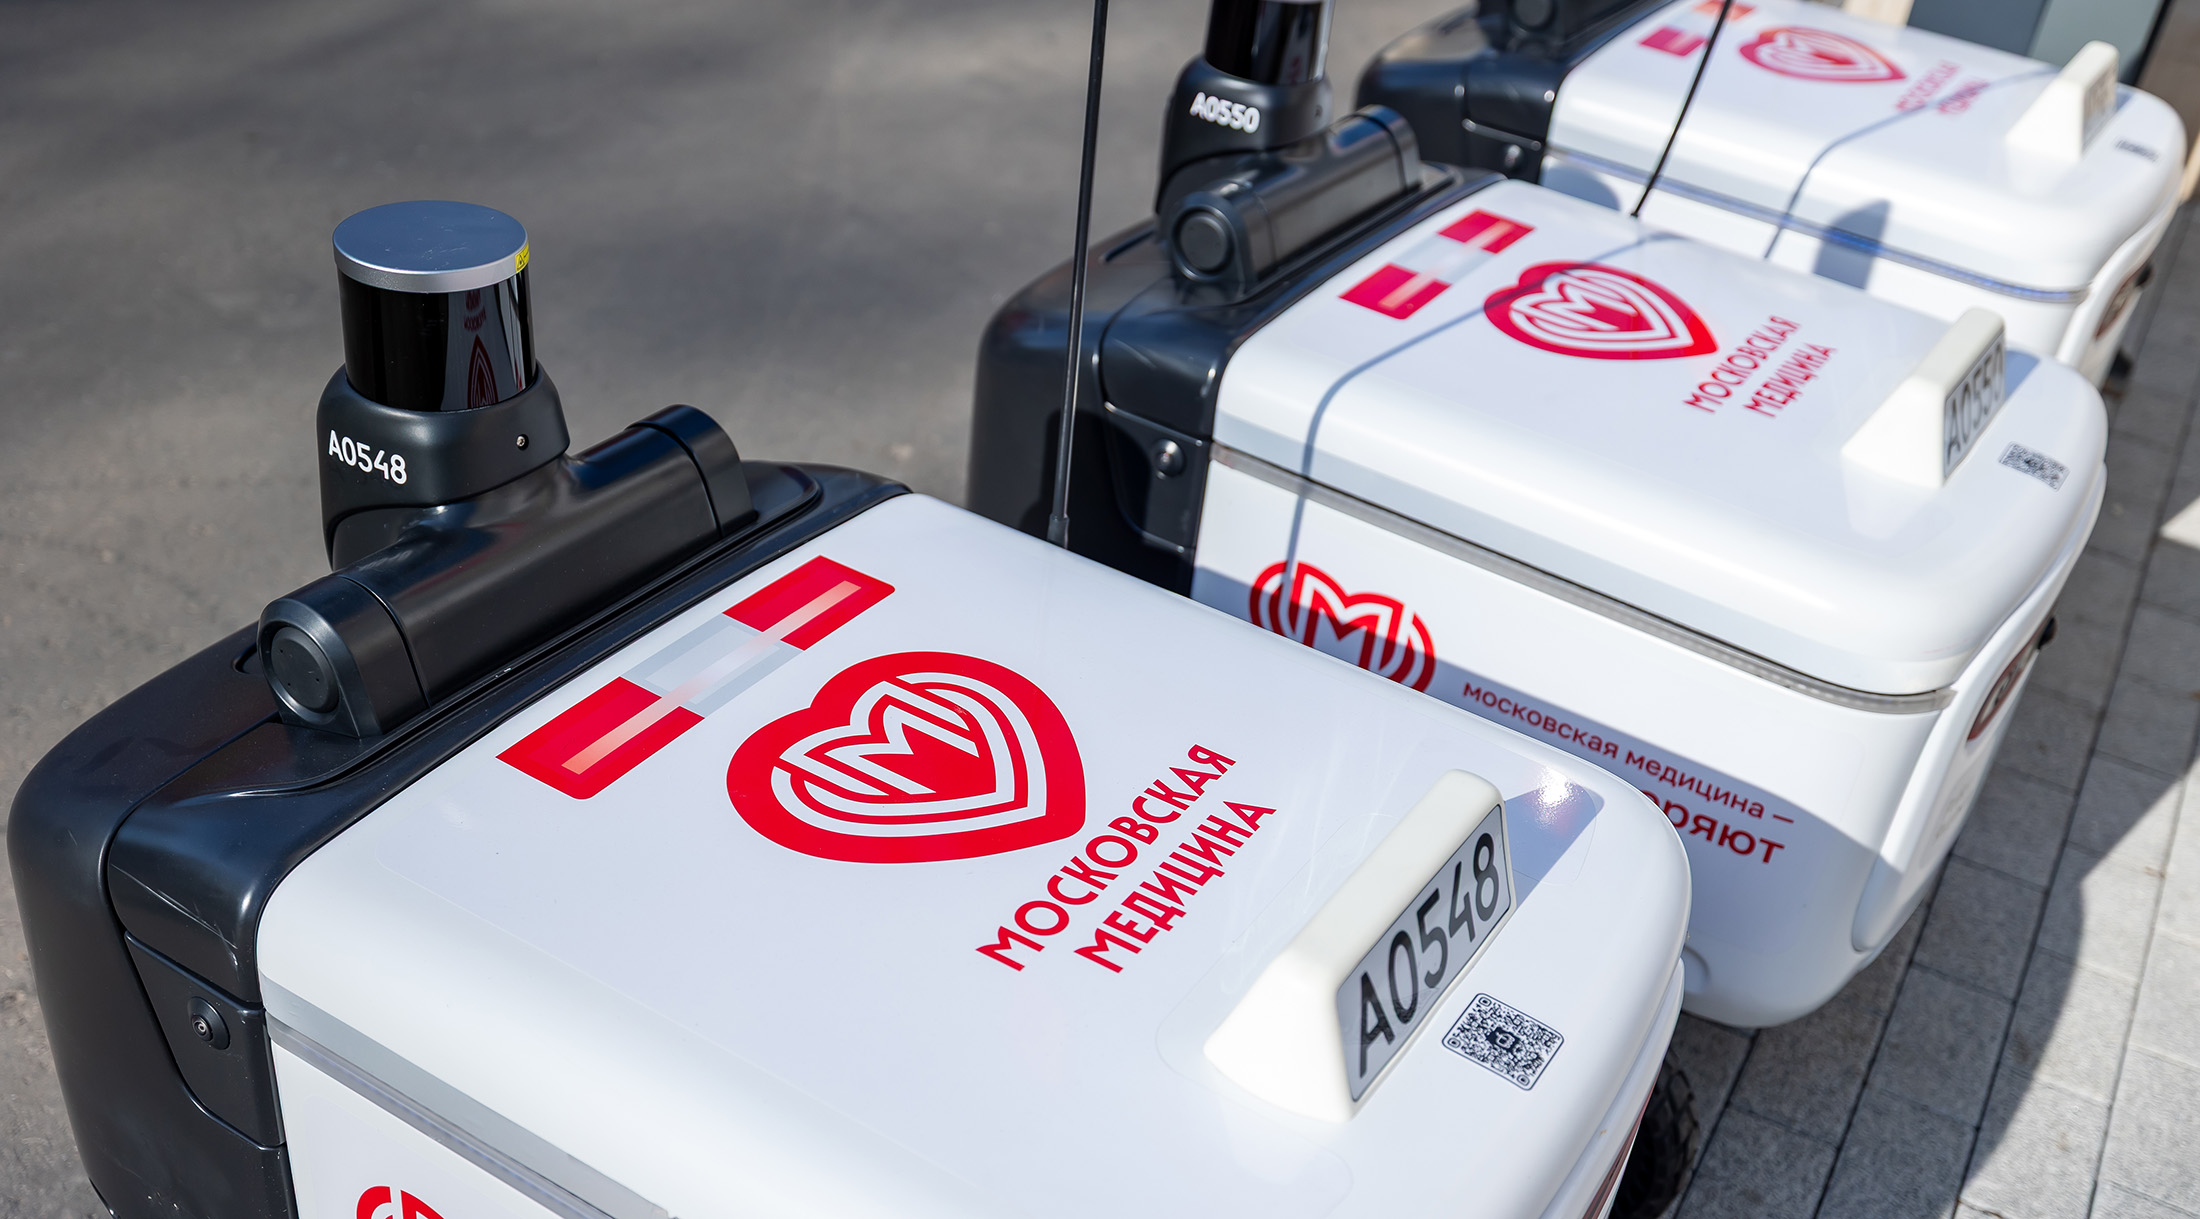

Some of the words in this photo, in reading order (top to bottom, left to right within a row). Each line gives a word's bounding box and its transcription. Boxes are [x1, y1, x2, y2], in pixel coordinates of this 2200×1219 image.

[1189, 91, 1261, 134] A0550
[1682, 314, 1801, 413] МОСКОВСКАЯ
[1742, 342, 1838, 417] МЕДИЦИНА
[328, 429, 407, 485] A0548
[1463, 682, 1619, 759] московская
[1625, 751, 1765, 819] медицина
[975, 744, 1236, 972] МОСКОВСКАЯ
[1642, 790, 1786, 864] ряют
[1073, 800, 1277, 974] МЕДИЦИНА
[1359, 832, 1500, 1079] A0548
